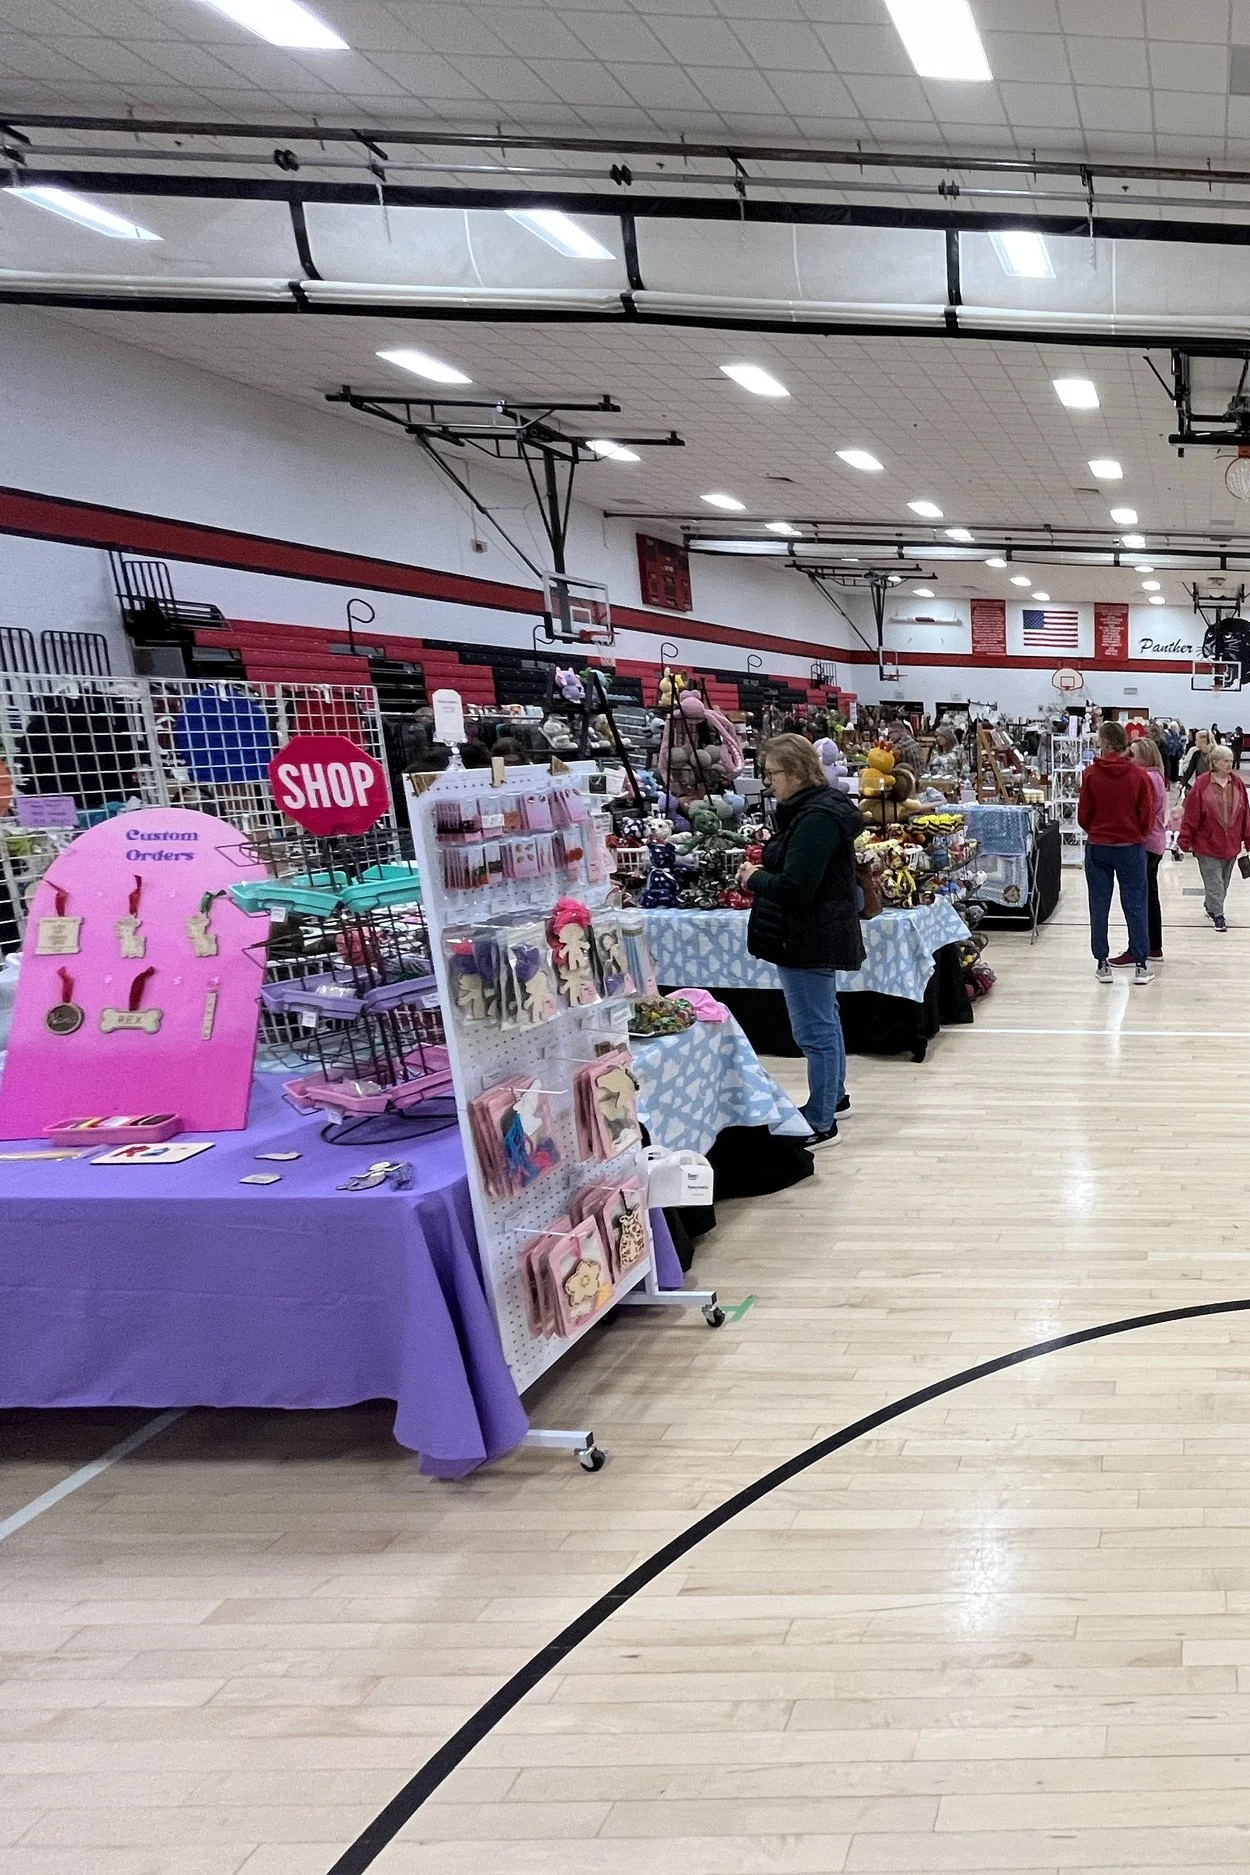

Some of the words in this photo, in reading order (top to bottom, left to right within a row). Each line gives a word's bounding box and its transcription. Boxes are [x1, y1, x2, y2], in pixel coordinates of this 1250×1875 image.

[1140, 638, 1193, 654] Panther
[277, 762, 375, 809] SHOP
[126, 829, 199, 841] Custom
[126, 849, 195, 861] Orders
